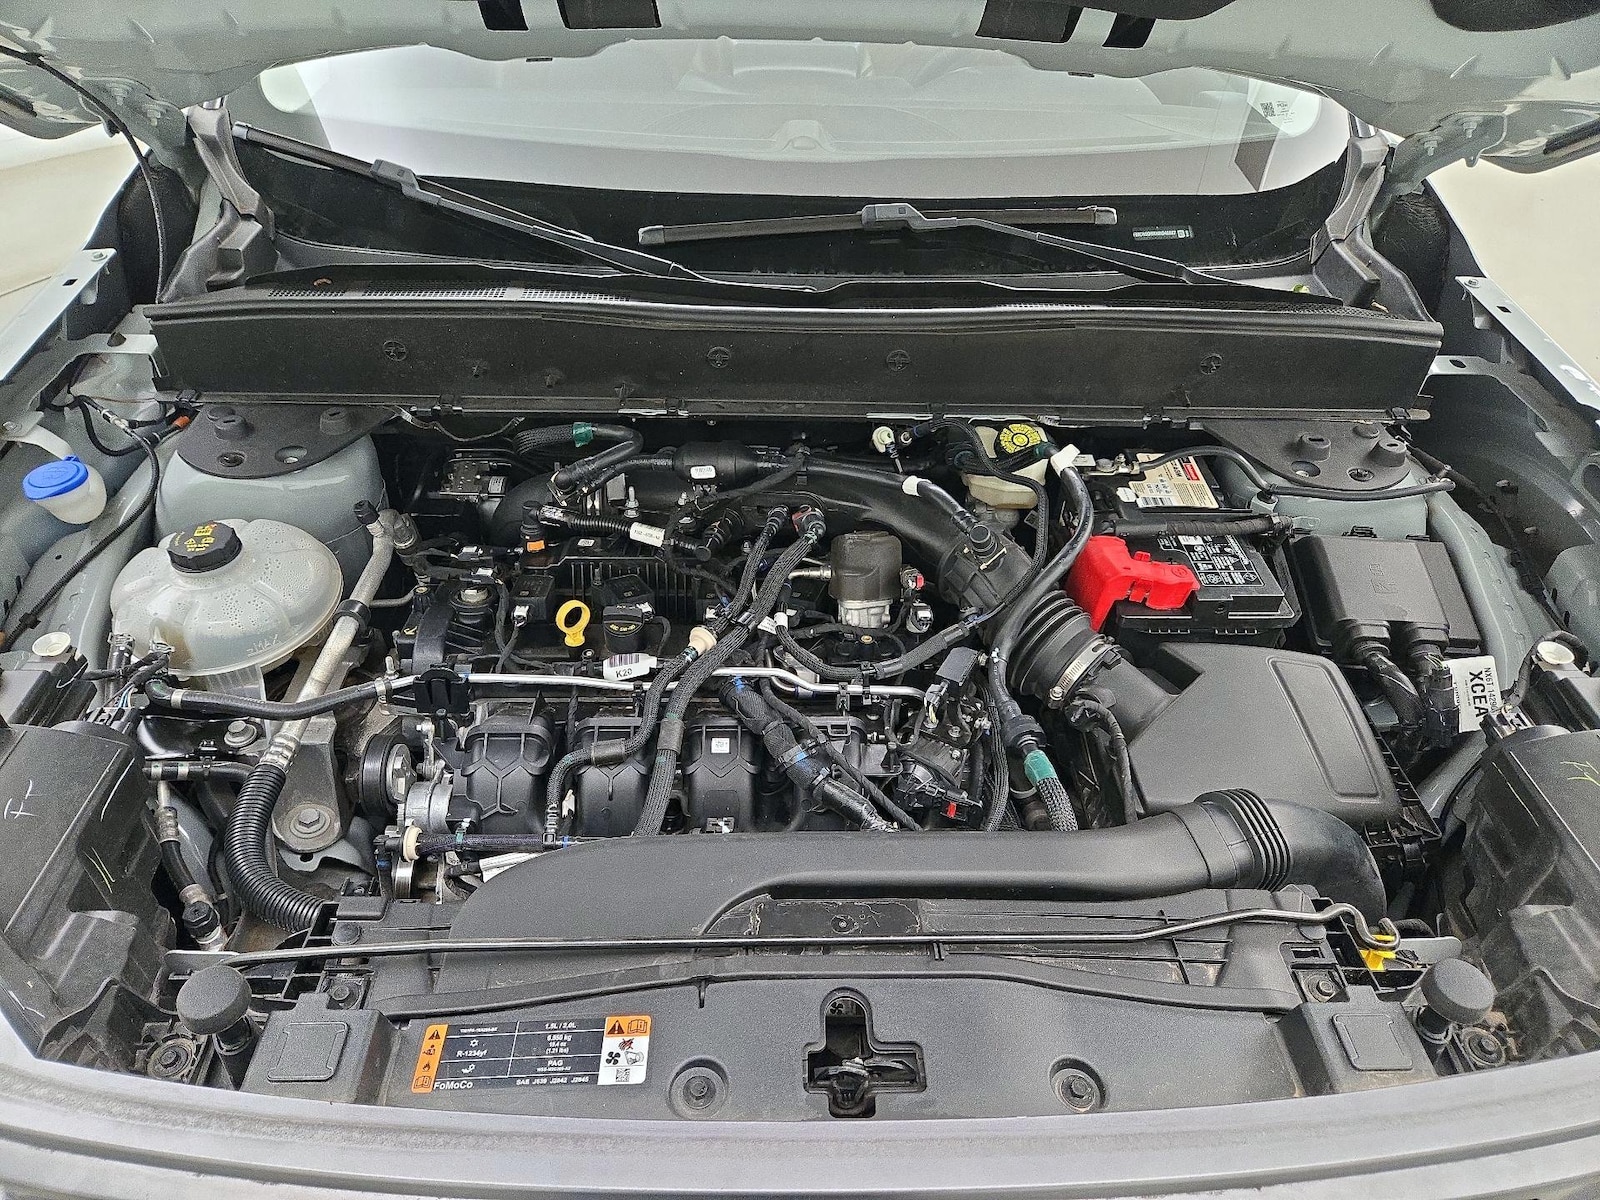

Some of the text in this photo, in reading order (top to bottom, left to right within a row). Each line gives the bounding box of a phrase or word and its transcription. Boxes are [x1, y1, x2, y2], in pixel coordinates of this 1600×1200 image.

[1484, 667, 1494, 686] NX6T
[1469, 670, 1488, 717] XCEA
[547, 1059, 564, 1067] PAG
[433, 1080, 474, 1090] FoMoCo
